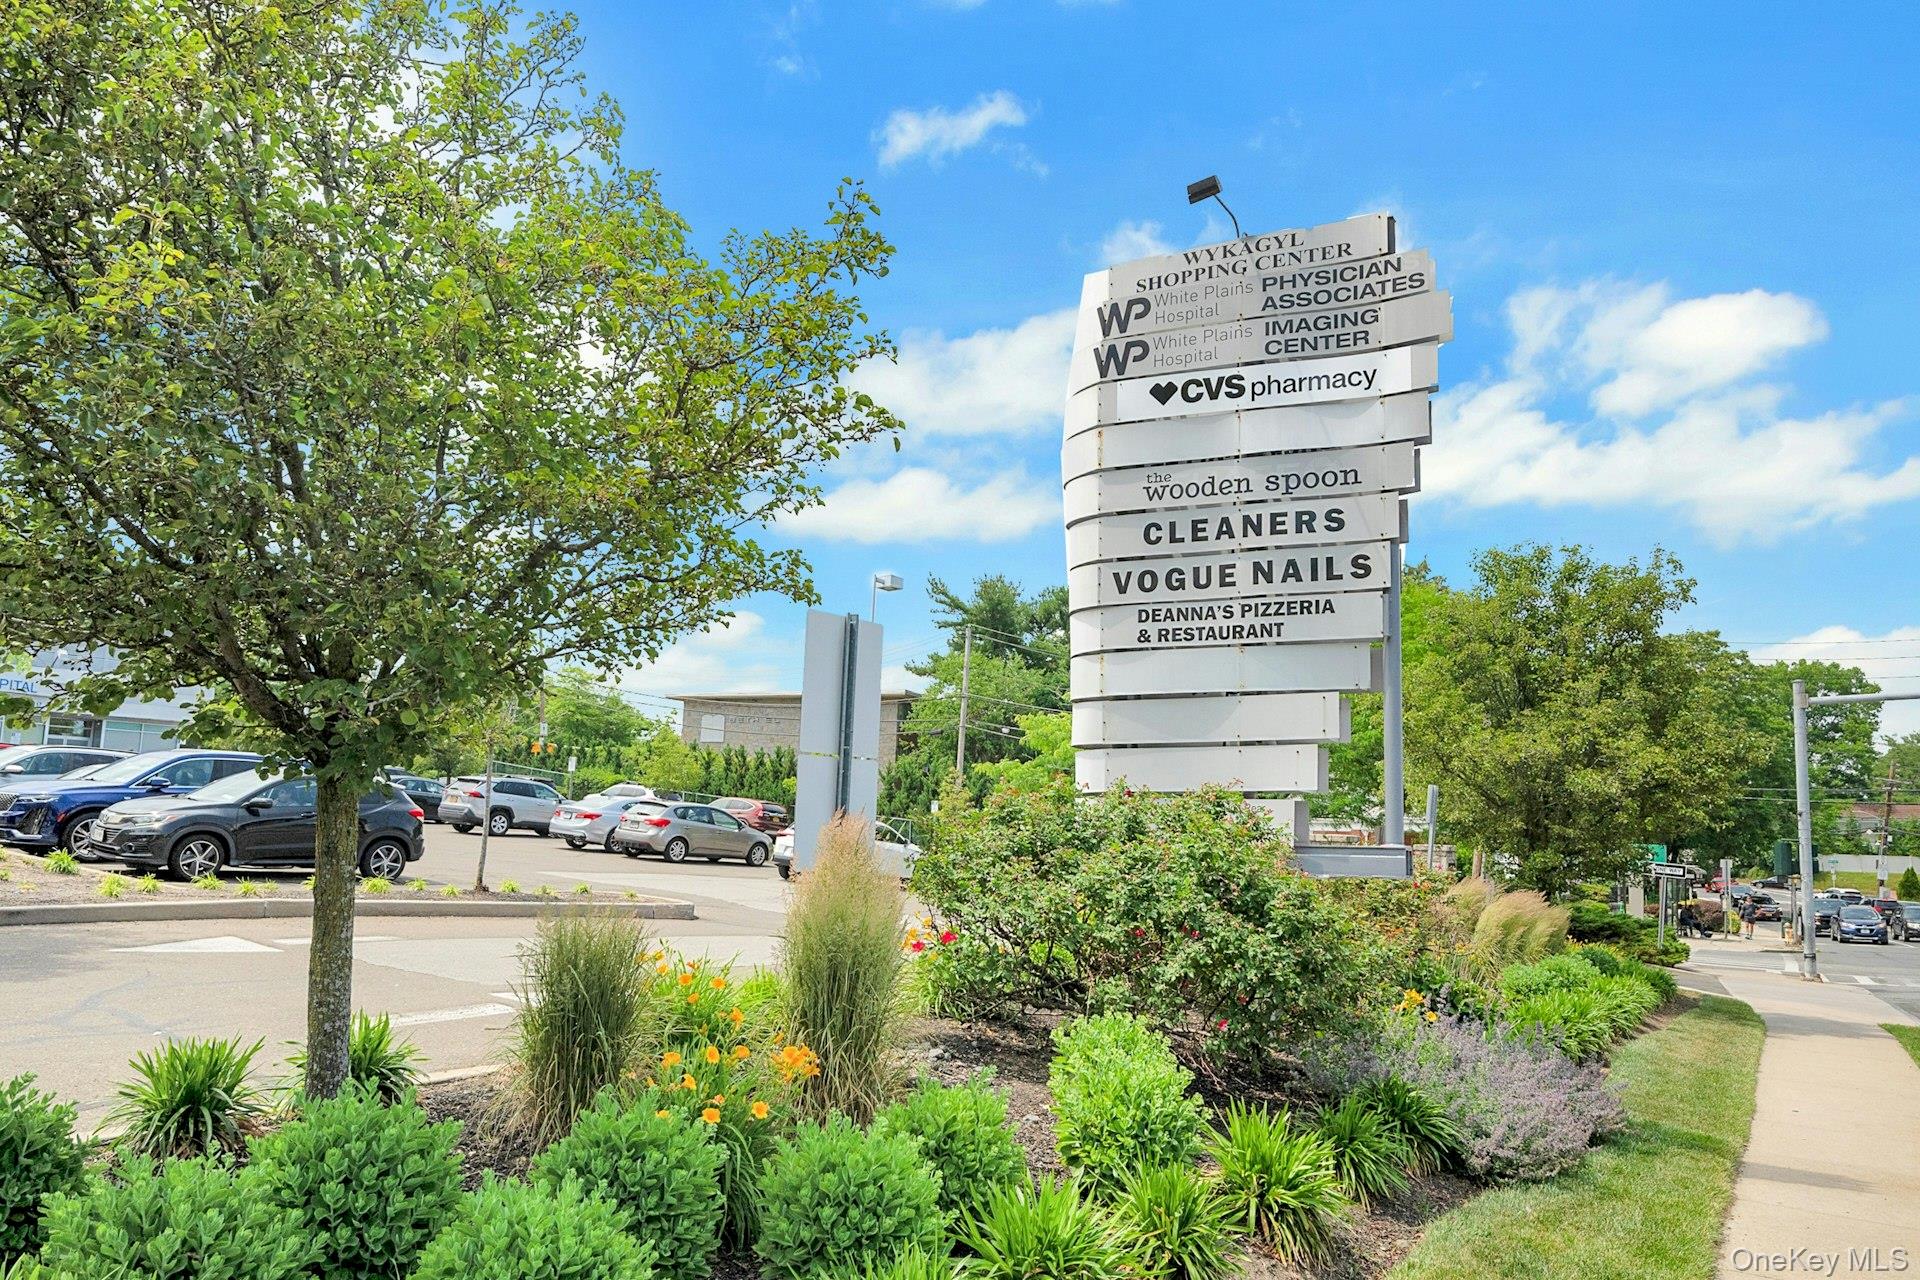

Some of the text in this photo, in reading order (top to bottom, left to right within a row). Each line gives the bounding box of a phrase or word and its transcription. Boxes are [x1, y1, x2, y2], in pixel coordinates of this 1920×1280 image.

[1183, 232, 1304, 266] WYKAGYL
[1136, 242, 1353, 293] SHOPPING CENTER
[1262, 257, 1402, 292] PHYSICIAN
[1154, 281, 1254, 307] White Plains
[1260, 272, 1425, 312] ASSOCIATES
[1097, 297, 1151, 338] WP
[1155, 302, 1219, 326] Hospital
[1264, 308, 1379, 337] IMAGING
[1153, 323, 1253, 348] White Plains
[1264, 330, 1370, 356] CENTER
[1094, 340, 1150, 378] WP
[1153, 345, 1218, 368] Hospital
[1180, 368, 1378, 403] CVS pharmacy
[1143, 466, 1362, 501] wooden spoon
[1146, 472, 1172, 484] the
[1143, 508, 1346, 545] CLEANERS
[1112, 553, 1373, 595] VOGUE NAILS
[1137, 598, 1335, 623] DEANNA'S PIZZERIA
[1137, 622, 1284, 643] & RESTAURANT
